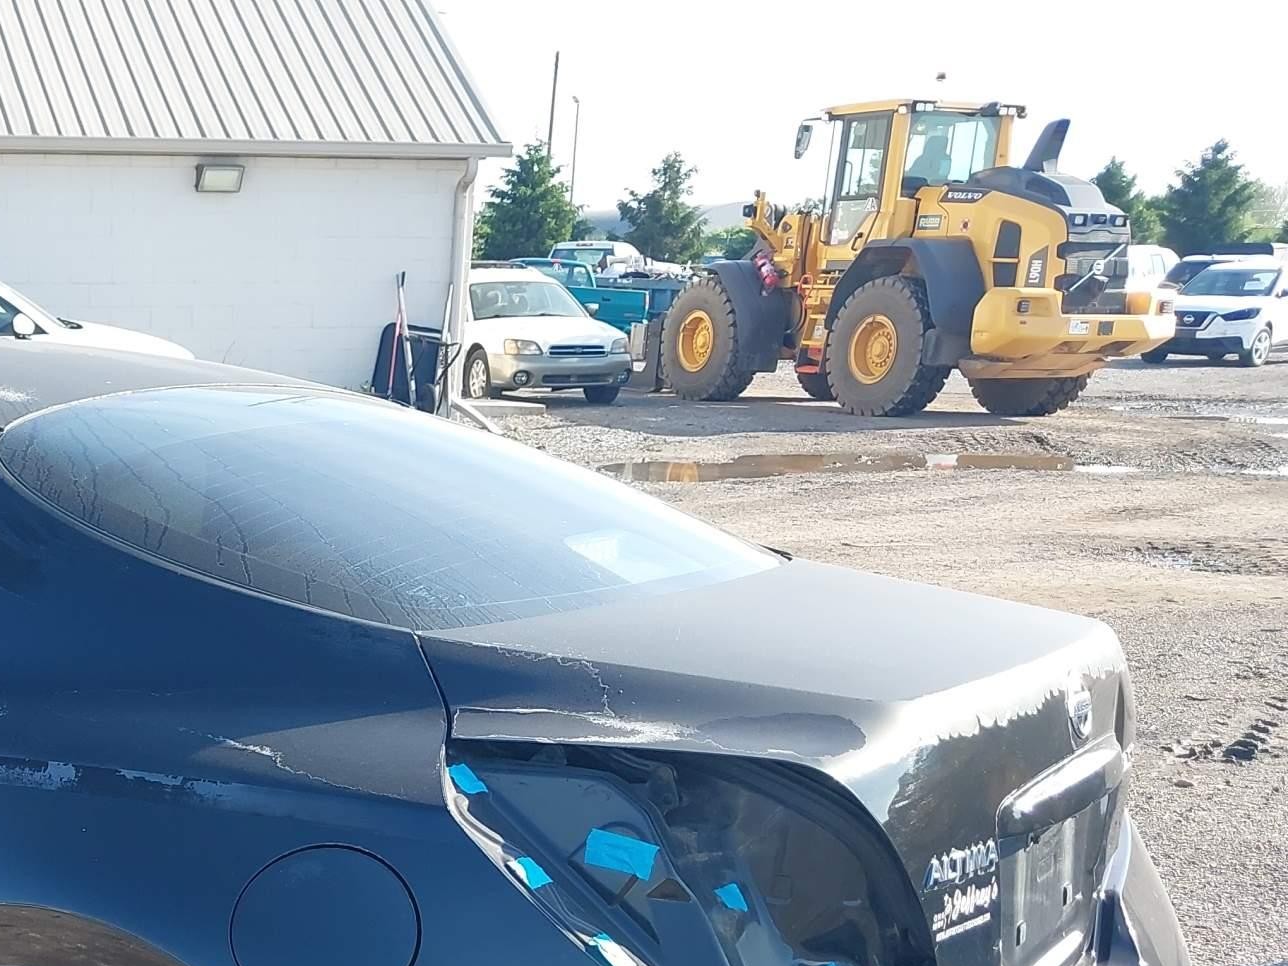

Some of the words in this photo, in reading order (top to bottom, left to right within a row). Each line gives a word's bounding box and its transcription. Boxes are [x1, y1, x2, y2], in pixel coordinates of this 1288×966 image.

[947, 191, 983, 200] VOLVO
[1028, 259, 1043, 283] L90H
[923, 838, 998, 887] ALTIMA
